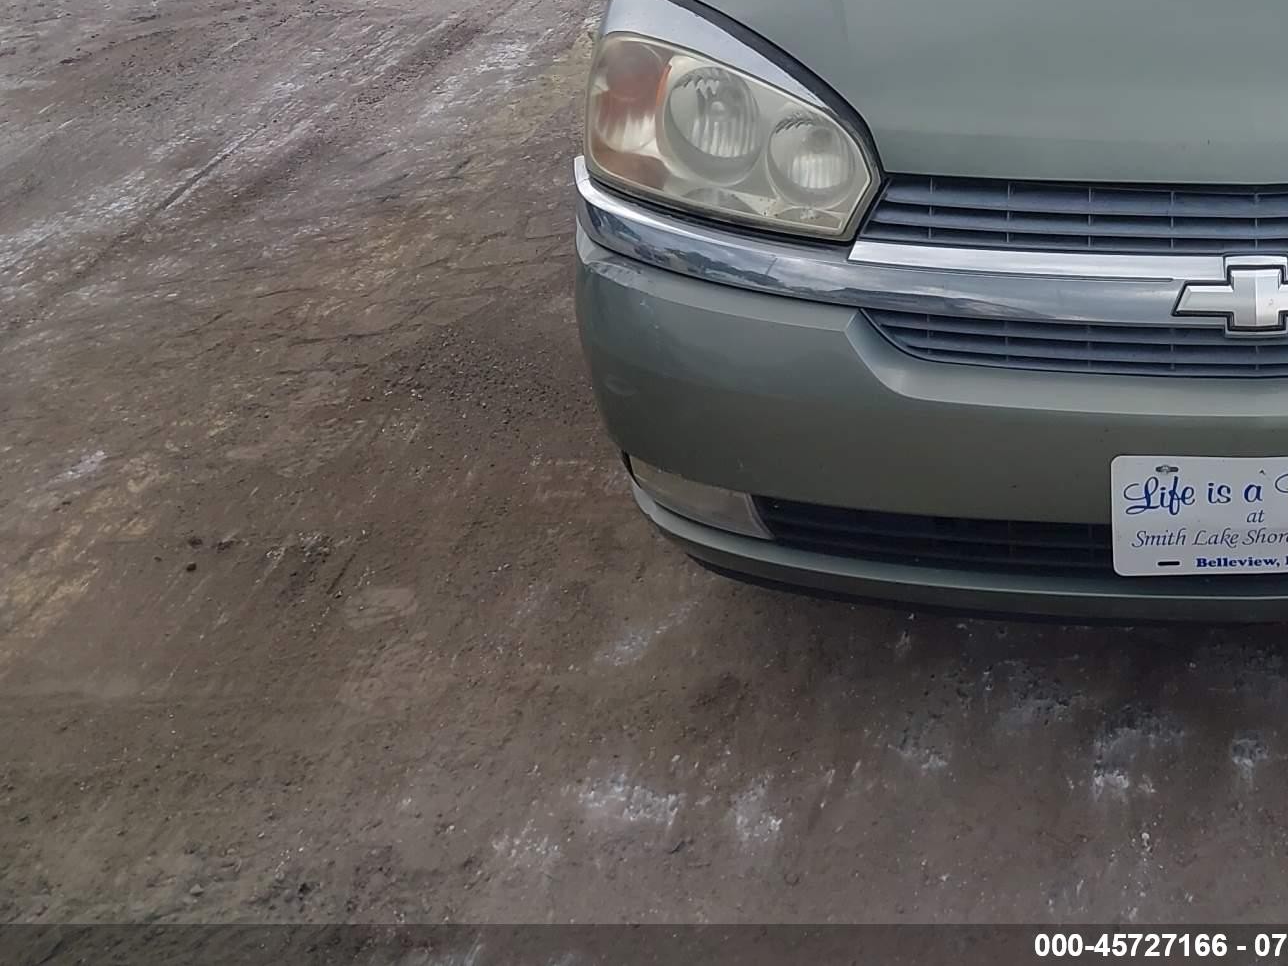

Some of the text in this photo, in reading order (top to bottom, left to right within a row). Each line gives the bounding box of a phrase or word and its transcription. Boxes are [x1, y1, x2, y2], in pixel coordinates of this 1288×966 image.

[1123, 475, 1195, 515] Life
[1207, 482, 1232, 505] is
[1243, 483, 1263, 503] a
[1246, 509, 1265, 523] at
[1131, 527, 1187, 548] Smith
[1192, 528, 1239, 548] Lake
[1196, 556, 1281, 569] Belleview,
